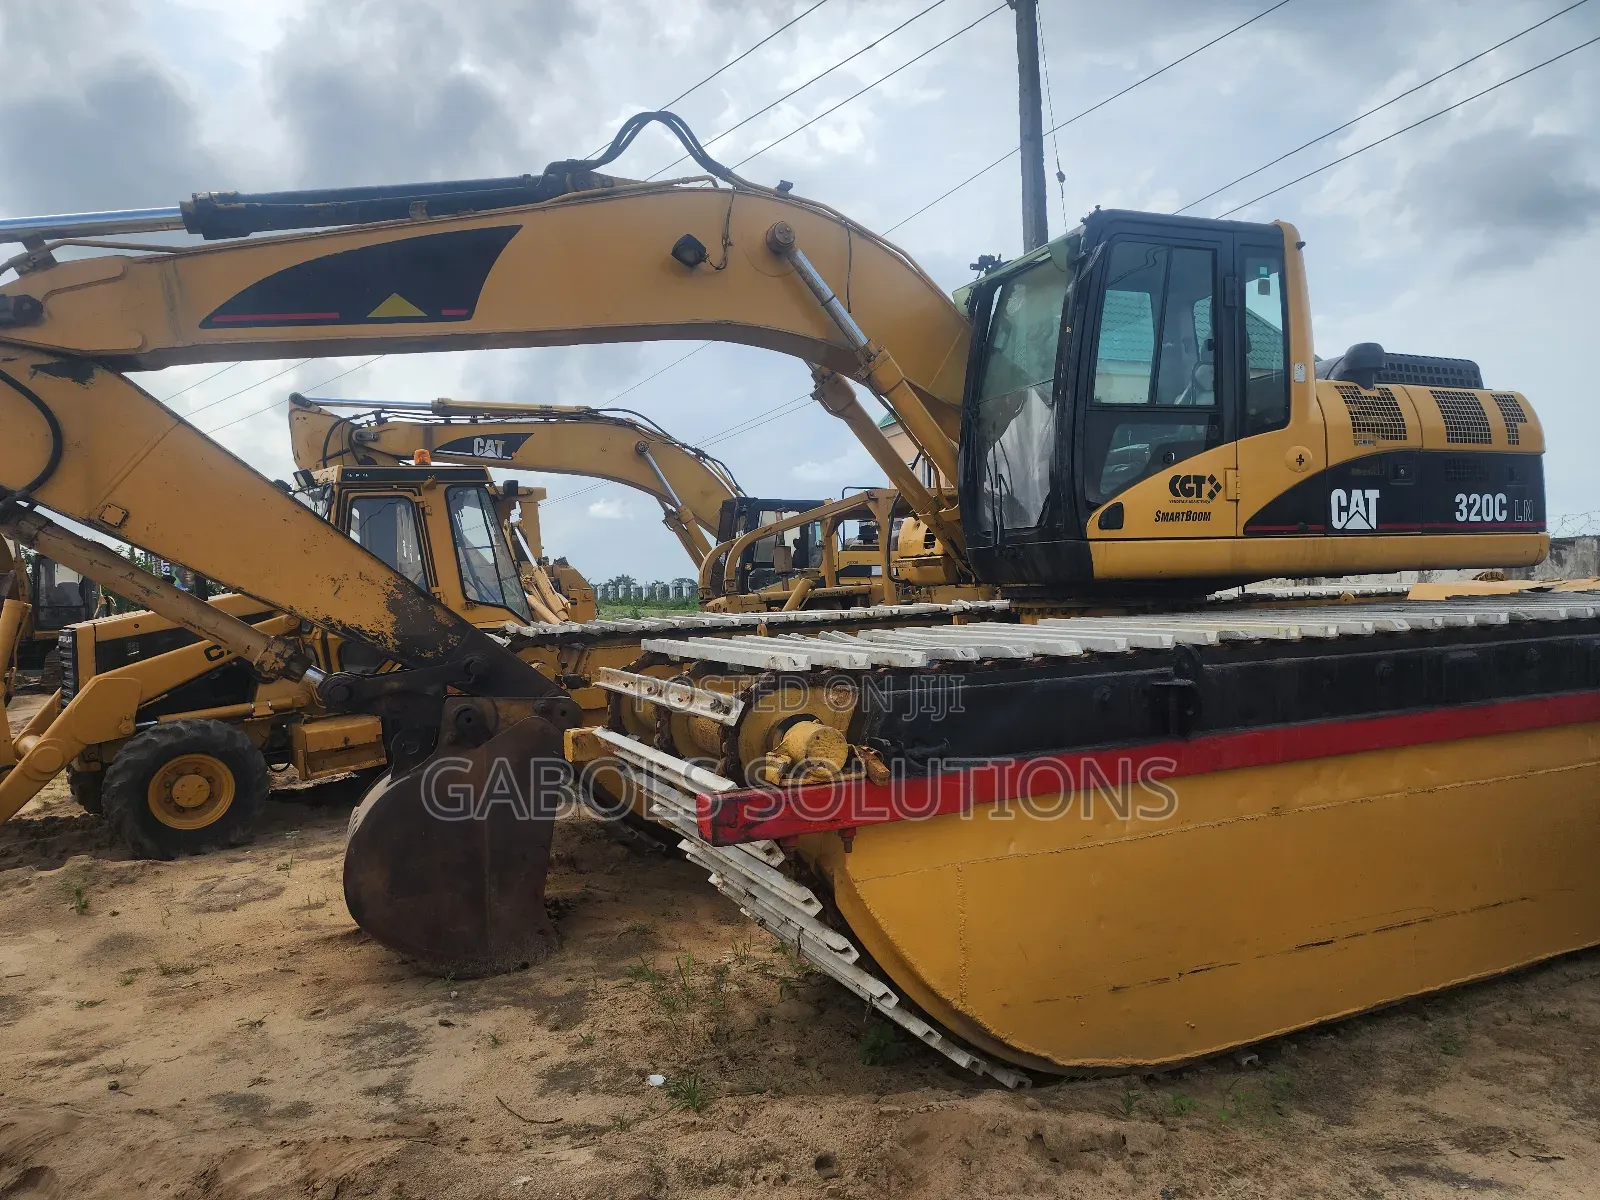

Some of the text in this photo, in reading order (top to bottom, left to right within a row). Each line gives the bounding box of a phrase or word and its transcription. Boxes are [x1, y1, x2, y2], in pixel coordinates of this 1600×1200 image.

[473, 437, 505, 458] CAT
[1169, 474, 1206, 498] CGT
[1331, 488, 1379, 530] CAT
[1455, 493, 1507, 523] 320C
